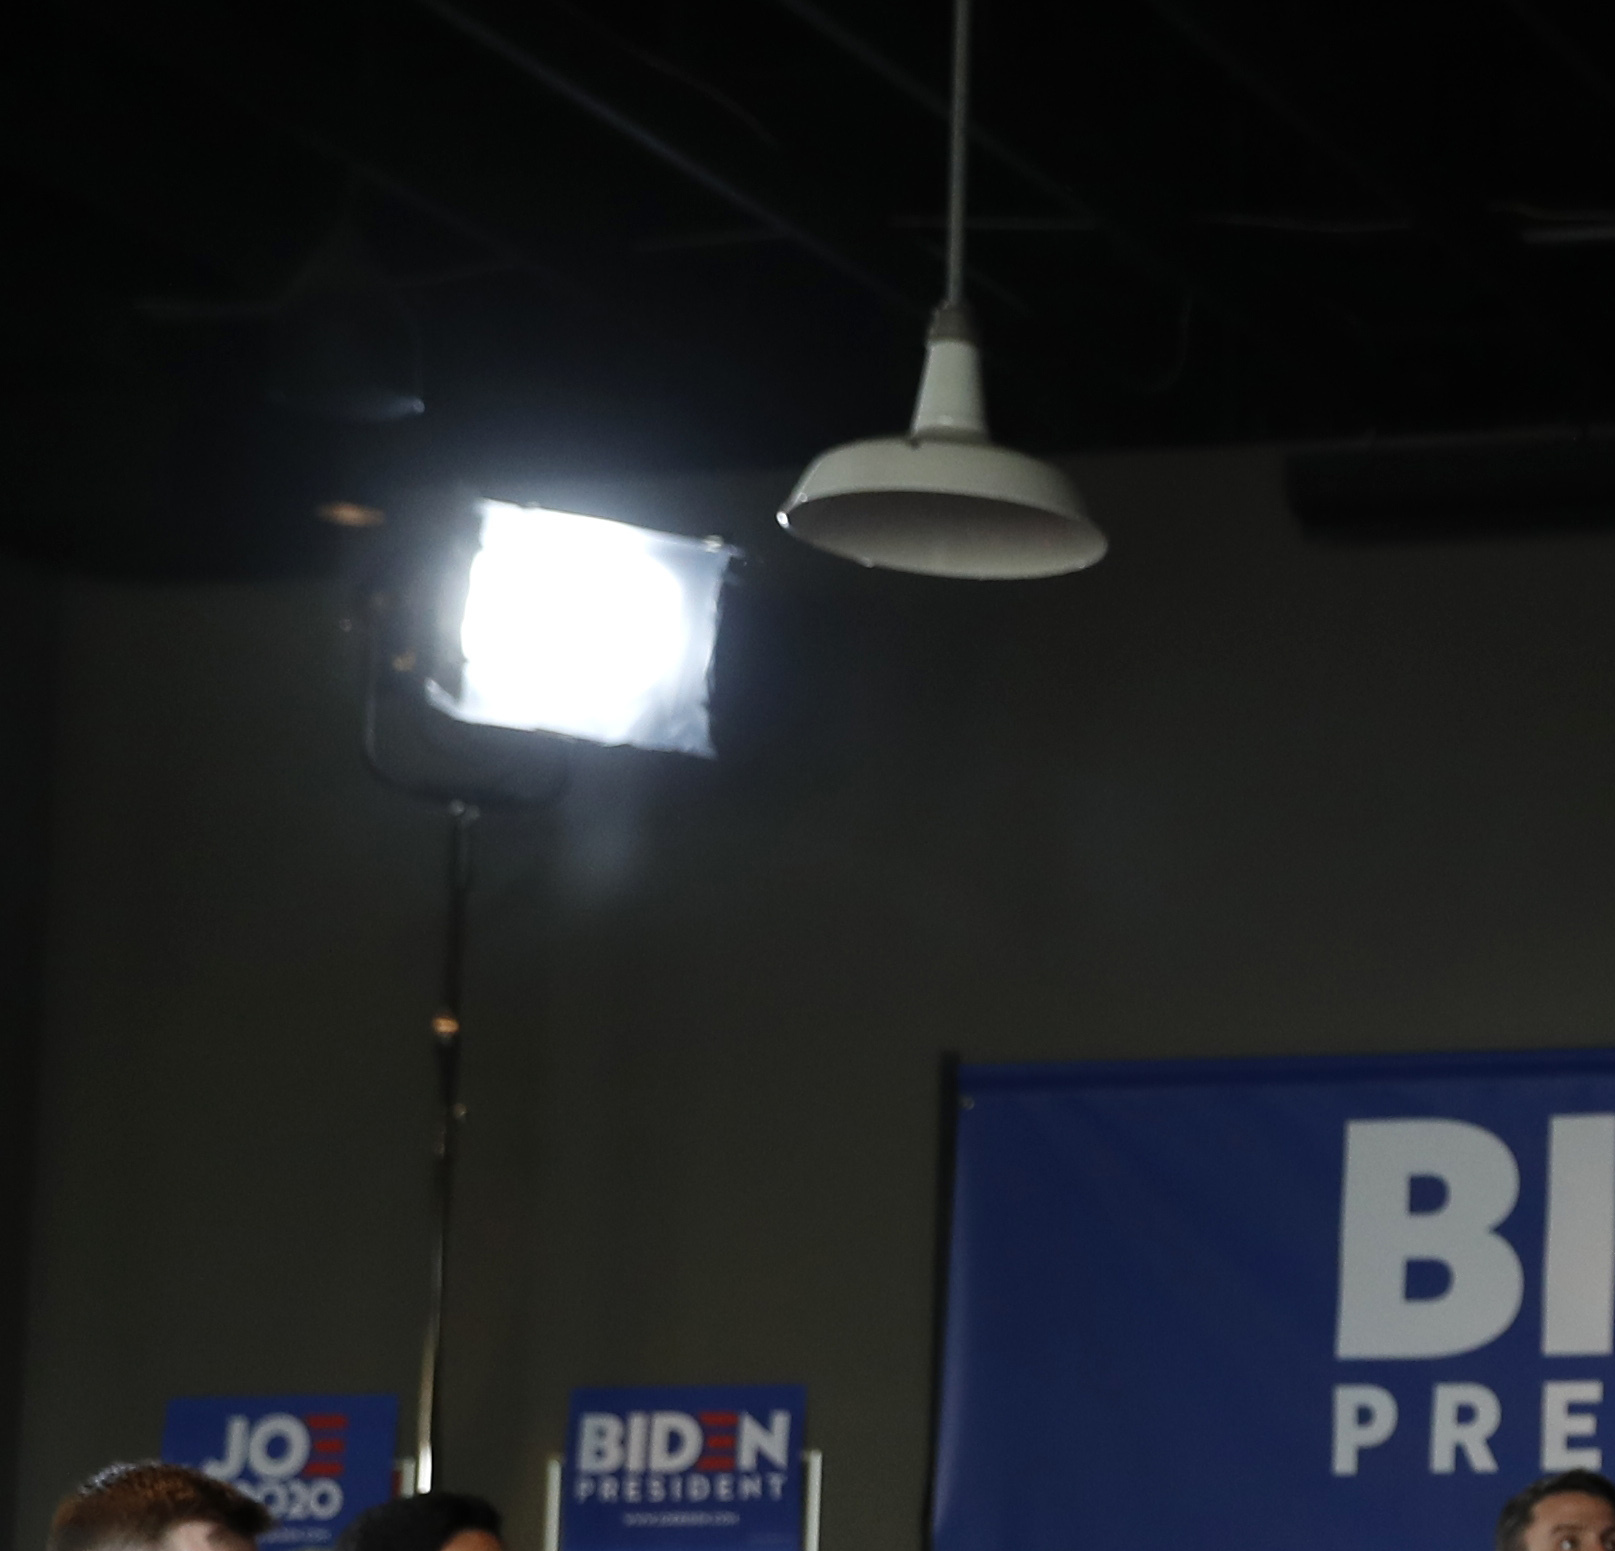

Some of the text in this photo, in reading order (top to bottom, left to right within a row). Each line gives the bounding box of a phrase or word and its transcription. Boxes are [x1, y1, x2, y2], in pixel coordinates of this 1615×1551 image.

[203, 1413, 348, 1482] JOE
[578, 1410, 791, 1474] BIDEN
[575, 1472, 787, 1502] PRESIDENT
